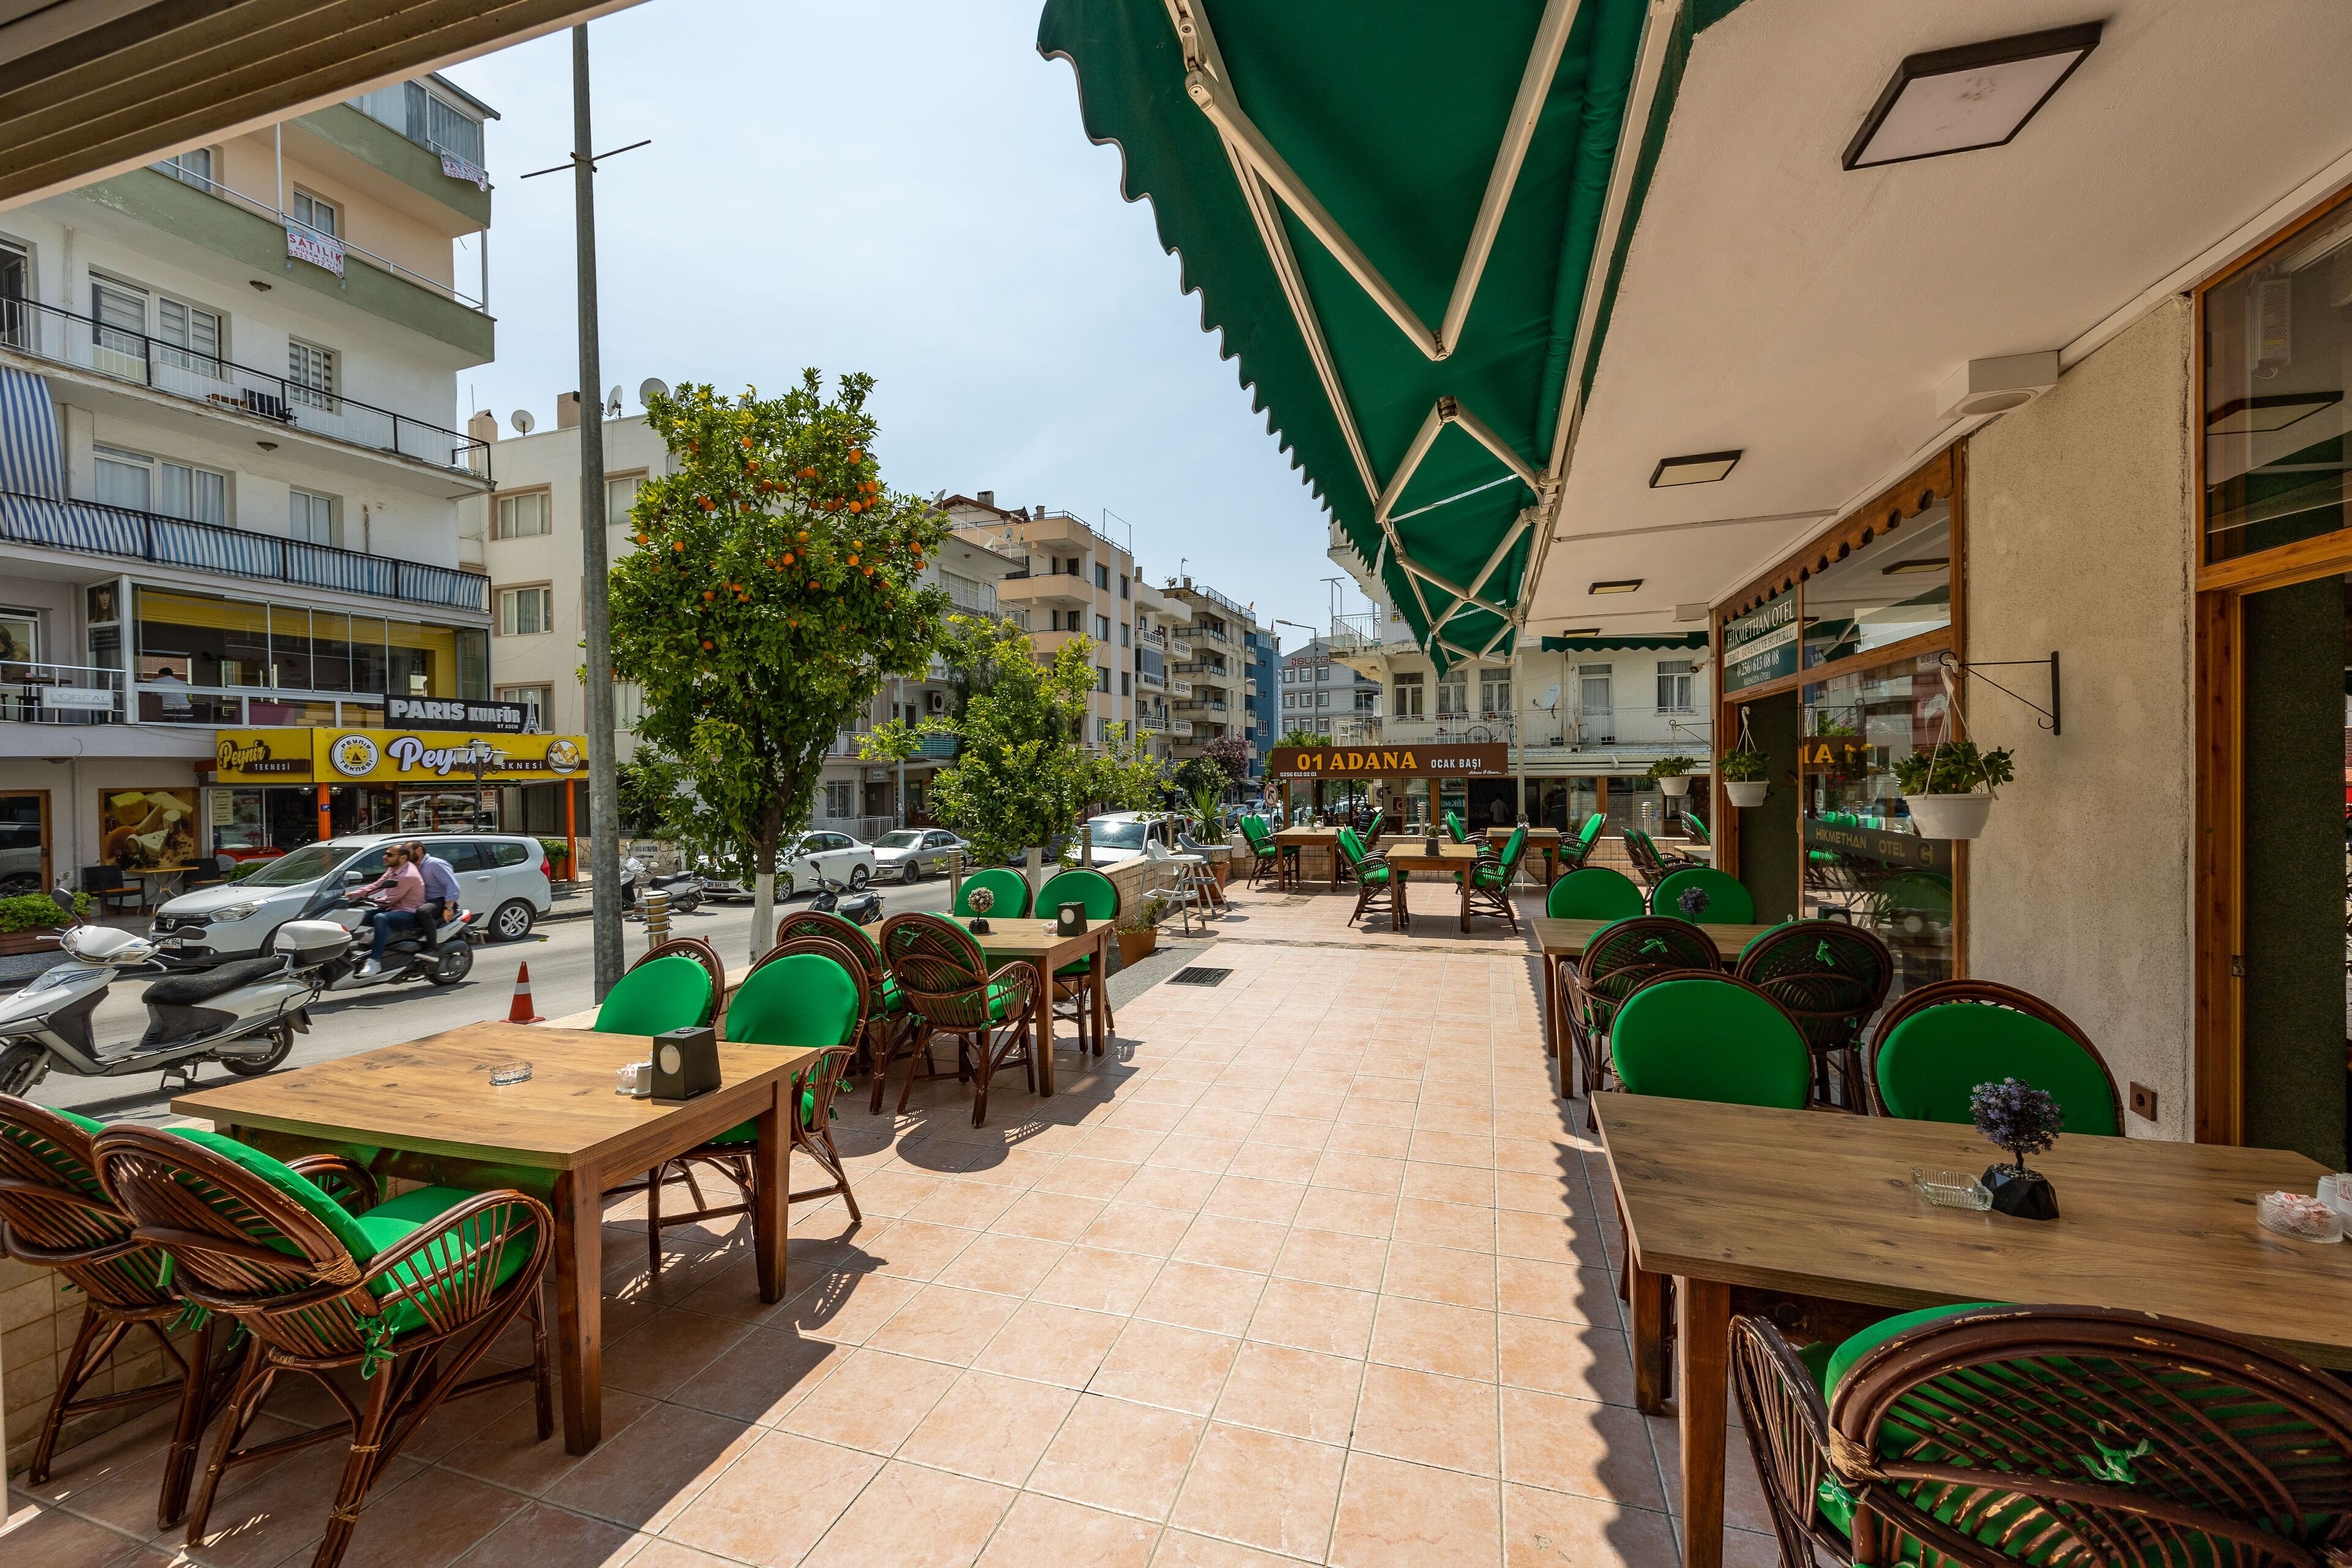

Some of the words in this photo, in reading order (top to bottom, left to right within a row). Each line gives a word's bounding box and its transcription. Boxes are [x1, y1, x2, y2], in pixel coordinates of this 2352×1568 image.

[288, 249, 307, 259] 0533
[289, 234, 342, 264] SATILIK
[1727, 611, 1770, 649] HİKMETHAN
[1772, 600, 1794, 627] OTEL
[1741, 639, 1761, 657] GÜVENLİ
[1761, 639, 1768, 649] VE
[1768, 627, 1793, 646] HUZURLU
[1753, 656, 1763, 672] 613
[1763, 652, 1771, 668] 08
[1772, 649, 1779, 665] 08
[389, 699, 465, 721] PARIS
[467, 706, 521, 723] KUAFÖR
[218, 741, 266, 772] Peynir
[255, 762, 290, 771] TEKNESİ
[501, 761, 543, 770] EKNESİ
[1297, 754, 1322, 770] 01
[1330, 752, 1417, 769] ADANA
[1431, 759, 1455, 768] OCAK
[1460, 759, 1480, 769] BAŞI
[1815, 826, 1867, 850] HİKMETHAN
[1879, 839, 1906, 858] OTEL
